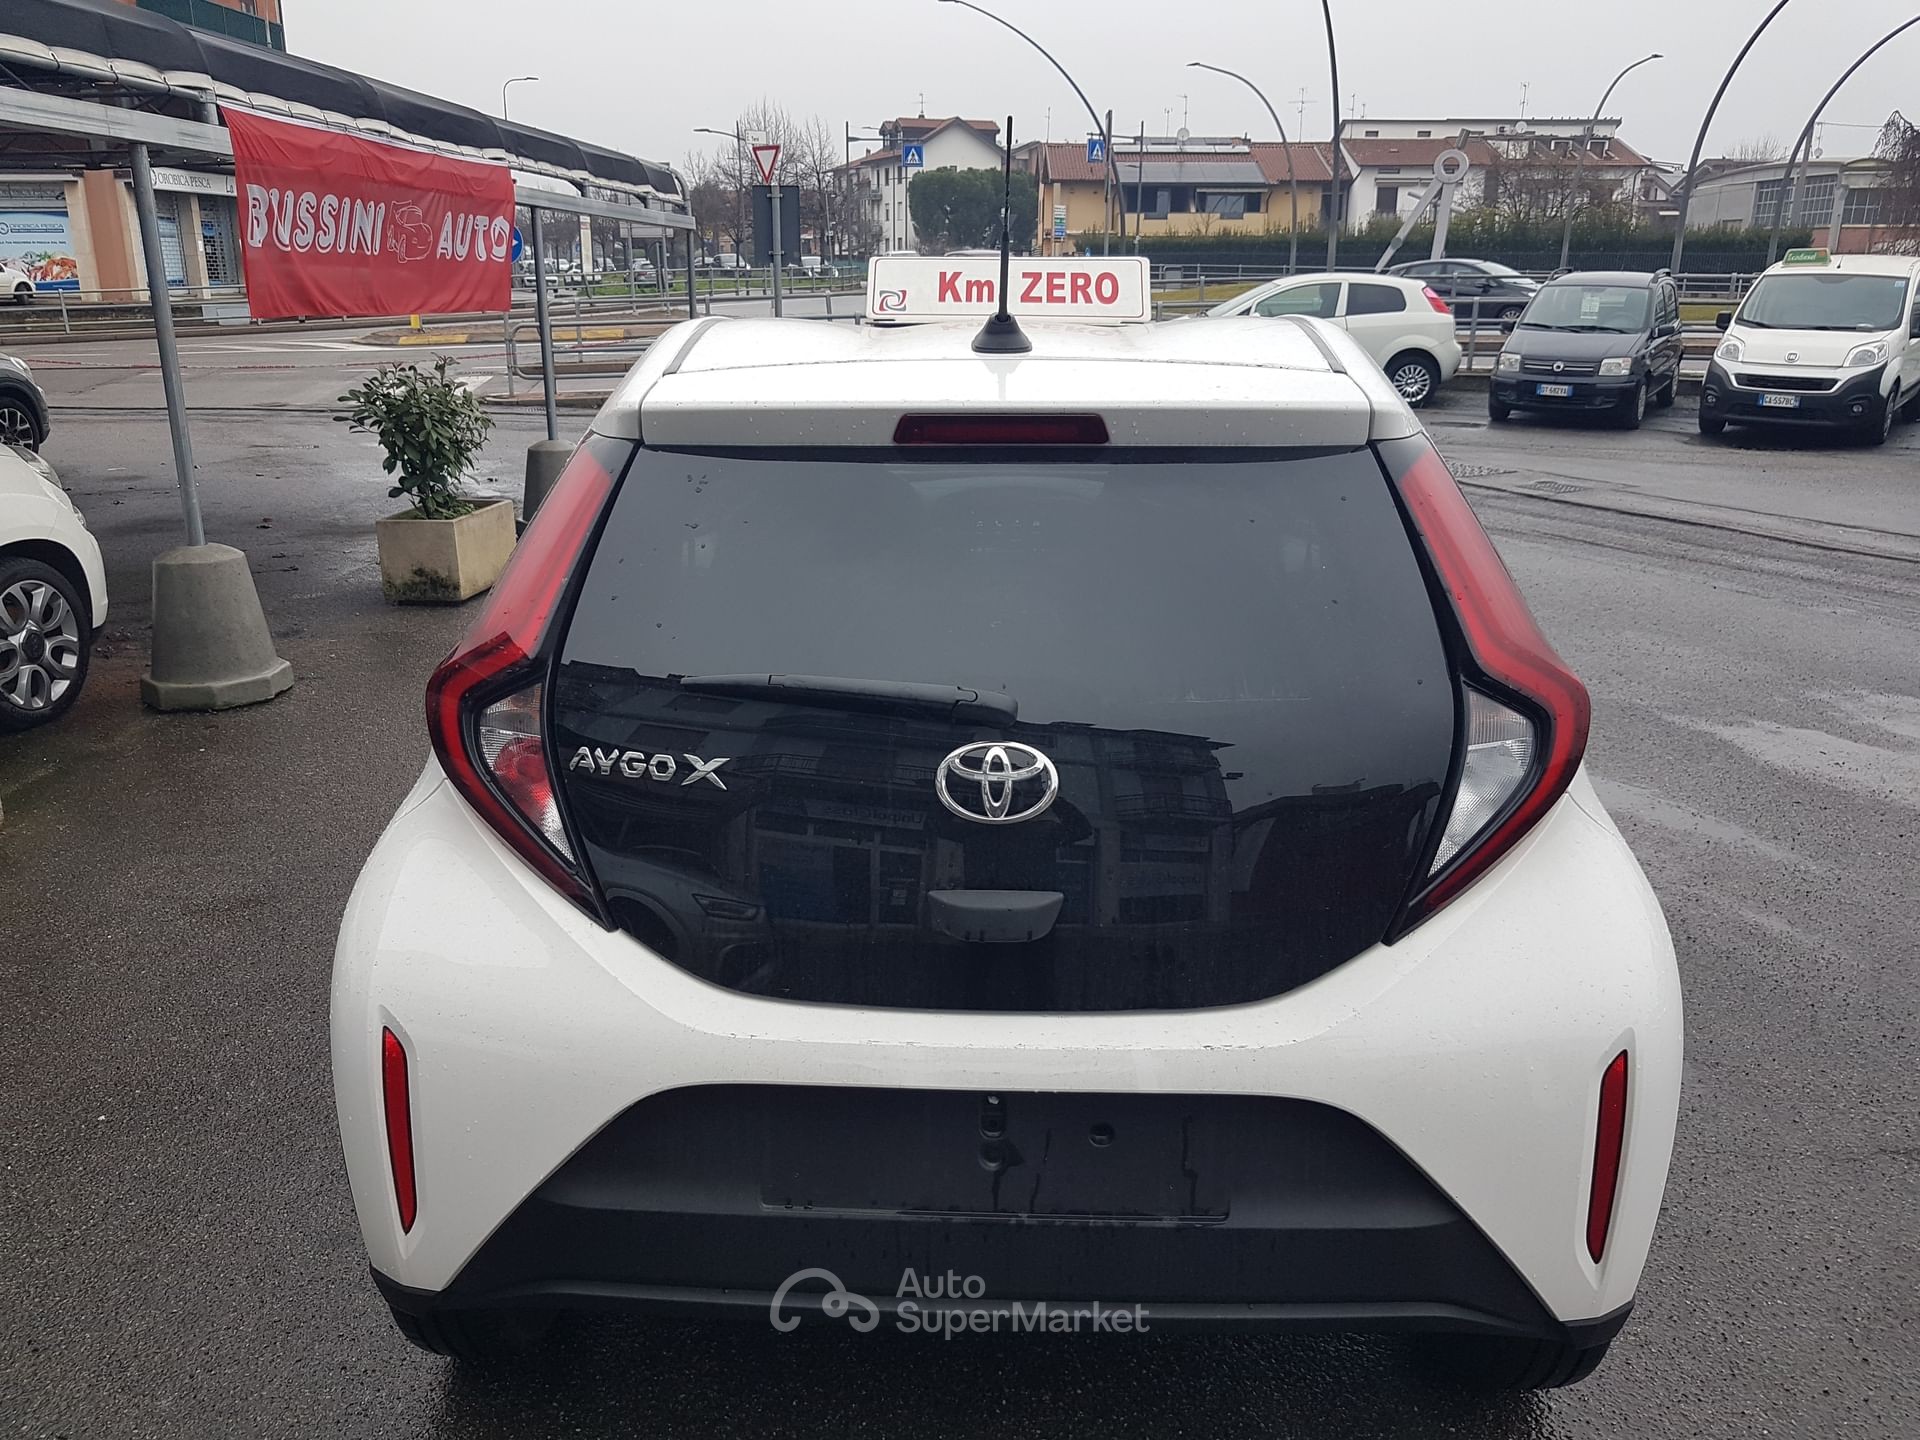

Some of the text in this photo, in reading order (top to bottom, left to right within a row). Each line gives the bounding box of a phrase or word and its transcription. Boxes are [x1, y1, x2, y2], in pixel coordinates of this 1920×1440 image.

[158, 172, 212, 189] OROBICA PESCA
[246, 183, 510, 262] BUSSINI AUTO
[938, 271, 1119, 305] Km ZERO
[569, 746, 731, 791] AYGO X
